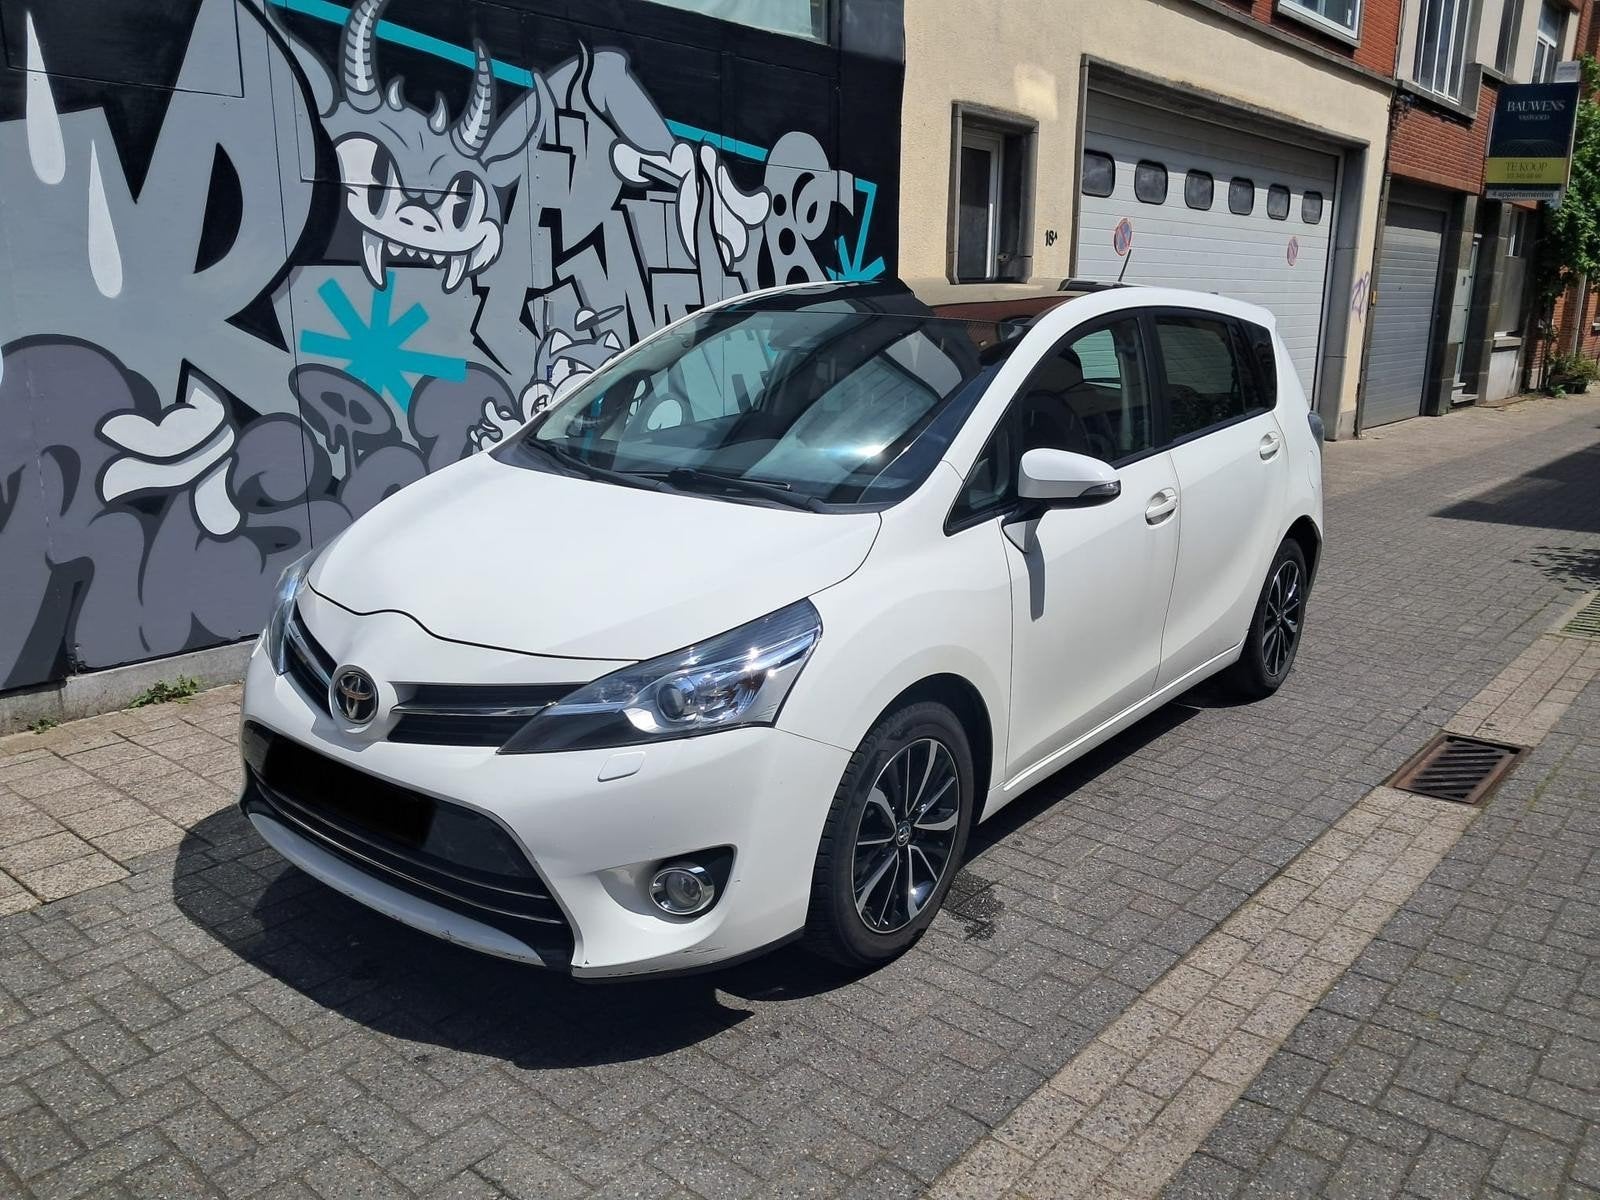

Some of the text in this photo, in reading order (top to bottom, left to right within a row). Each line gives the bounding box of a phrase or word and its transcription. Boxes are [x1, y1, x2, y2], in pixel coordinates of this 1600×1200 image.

[1507, 100, 1566, 112] BAUWENS
[1505, 162, 1548, 172] TE KOOP
